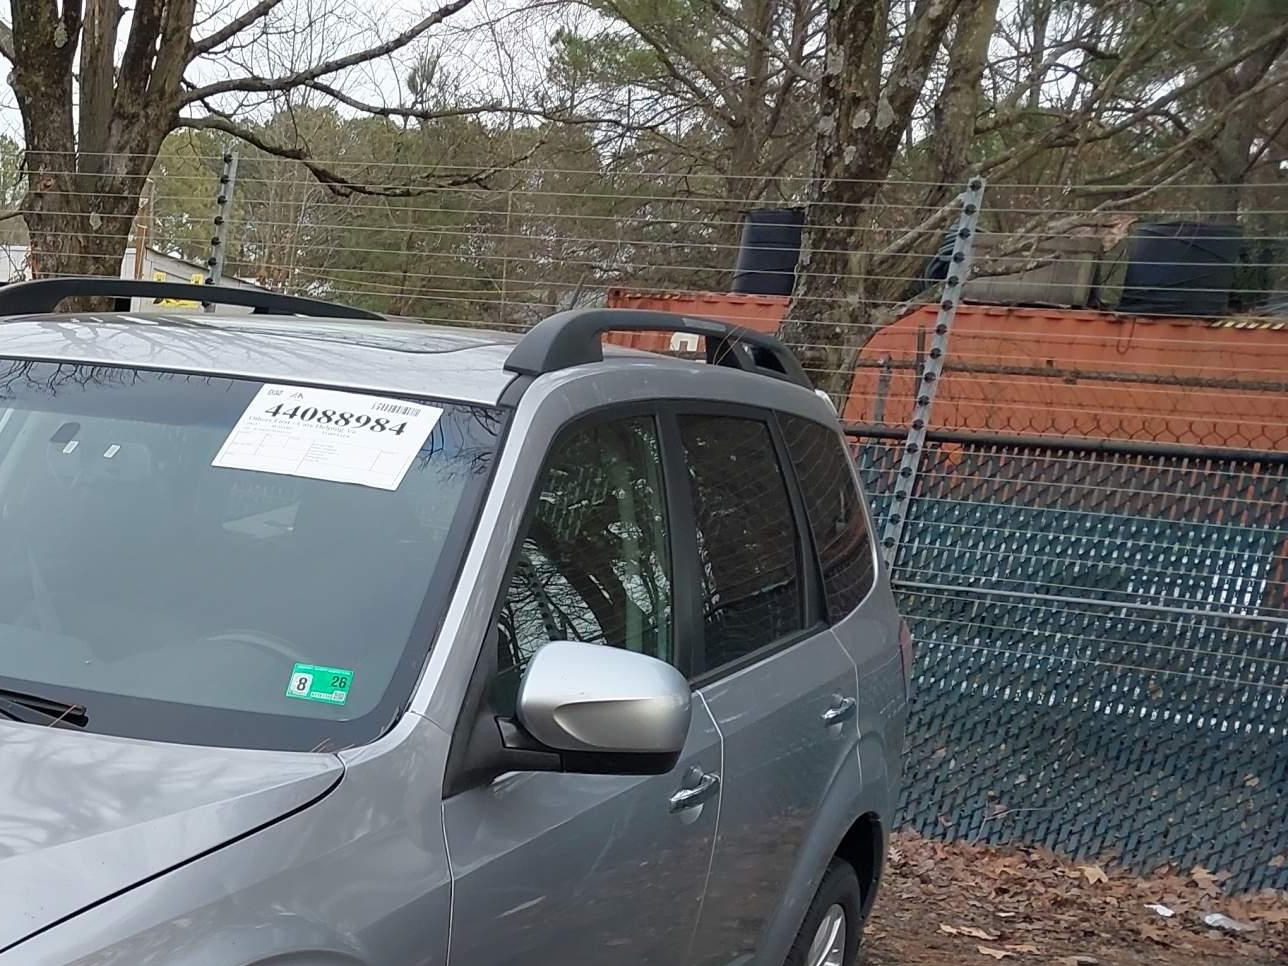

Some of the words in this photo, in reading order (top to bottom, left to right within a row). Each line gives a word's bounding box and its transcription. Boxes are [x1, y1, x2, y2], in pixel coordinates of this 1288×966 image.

[264, 402, 409, 436] 44088984
[296, 677, 308, 691] 8
[330, 675, 348, 689] 26
